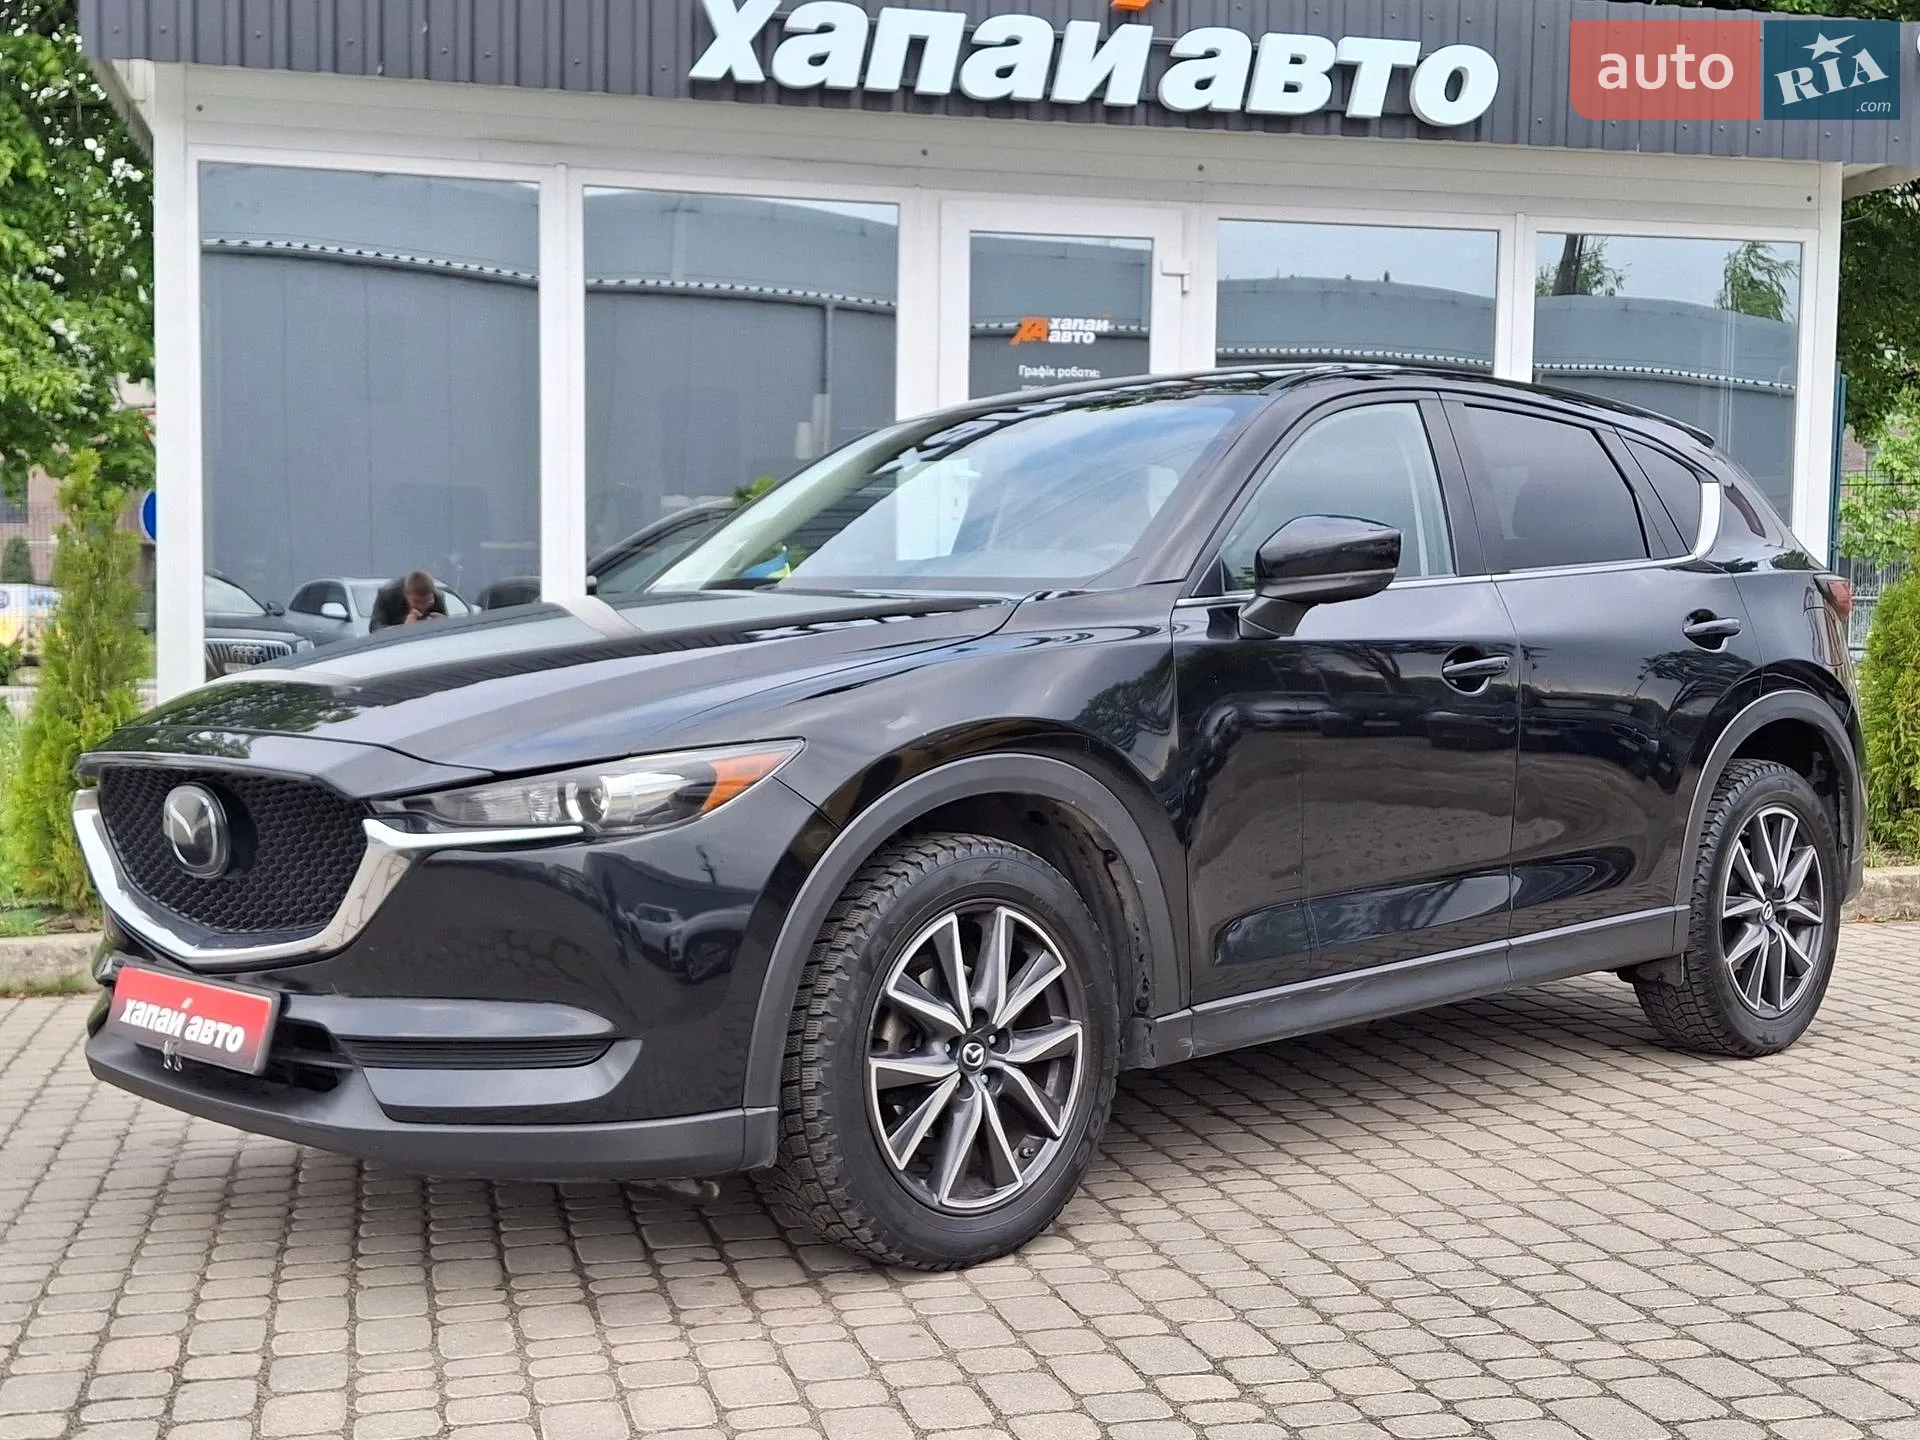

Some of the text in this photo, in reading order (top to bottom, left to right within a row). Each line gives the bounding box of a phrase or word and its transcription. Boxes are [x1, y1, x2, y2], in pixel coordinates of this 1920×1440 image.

[1157, 26, 1499, 127] авто
[1048, 330, 1096, 344] авто
[1018, 364, 1056, 378] Графік
[184, 1015, 246, 1053] авто
